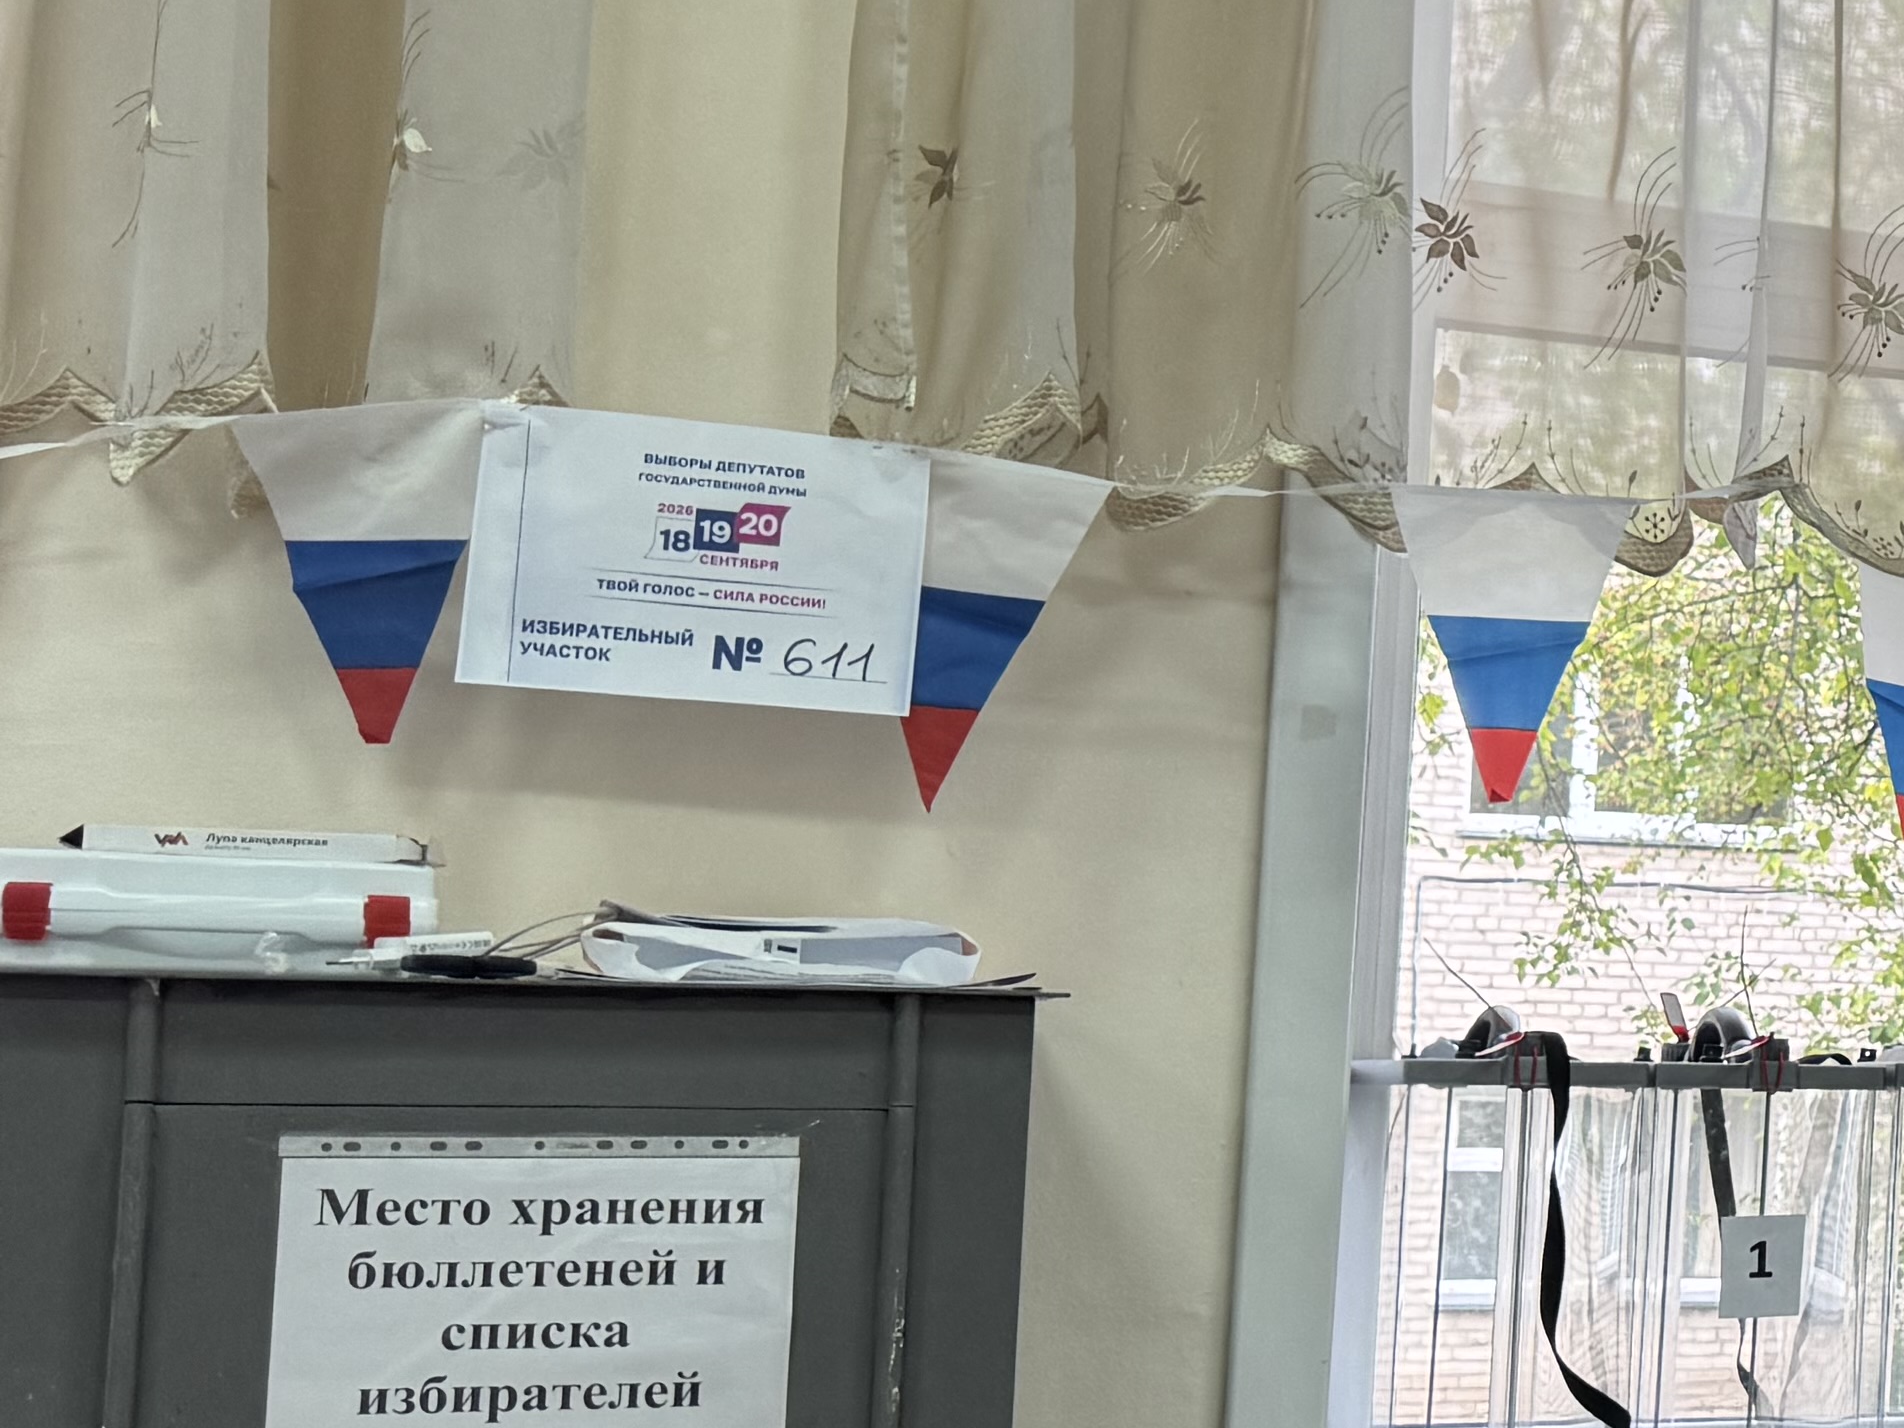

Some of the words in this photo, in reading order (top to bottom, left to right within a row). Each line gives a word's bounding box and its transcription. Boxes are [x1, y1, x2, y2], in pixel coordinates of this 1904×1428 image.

[643, 453, 712, 470] ВЫБОРЫ
[715, 460, 807, 480] ДЕПУТАТОВ
[638, 472, 767, 493] ГОСУДАРСТВЕННОЙ
[768, 486, 808, 498] ДУМЫ
[657, 502, 694, 516] 2026
[659, 528, 692, 553] 18
[699, 519, 733, 545] 19
[738, 512, 779, 538] 20
[699, 553, 780, 572] СЕНТЯБРЯ
[597, 577, 640, 594] ТВОЙ
[643, 582, 696, 599] ГОЛОС
[713, 588, 756, 604] СИЛА
[759, 593, 827, 611] РОССИИ!
[521, 618, 695, 648] ИЗБИРАТЕЛЬНЫЙ
[519, 641, 612, 663] УЧАСТОК
[711, 634, 764, 673] №
[783, 637, 876, 683] 611
[205, 832, 238, 844] Лупа
[314, 1187, 492, 1228] Место
[509, 1196, 765, 1236] хранения
[347, 1248, 677, 1290] бюллетеней
[695, 1257, 727, 1286] и
[1748, 1240, 1774, 1279] 1
[440, 1318, 631, 1351] списка
[356, 1370, 704, 1424] избирателей
